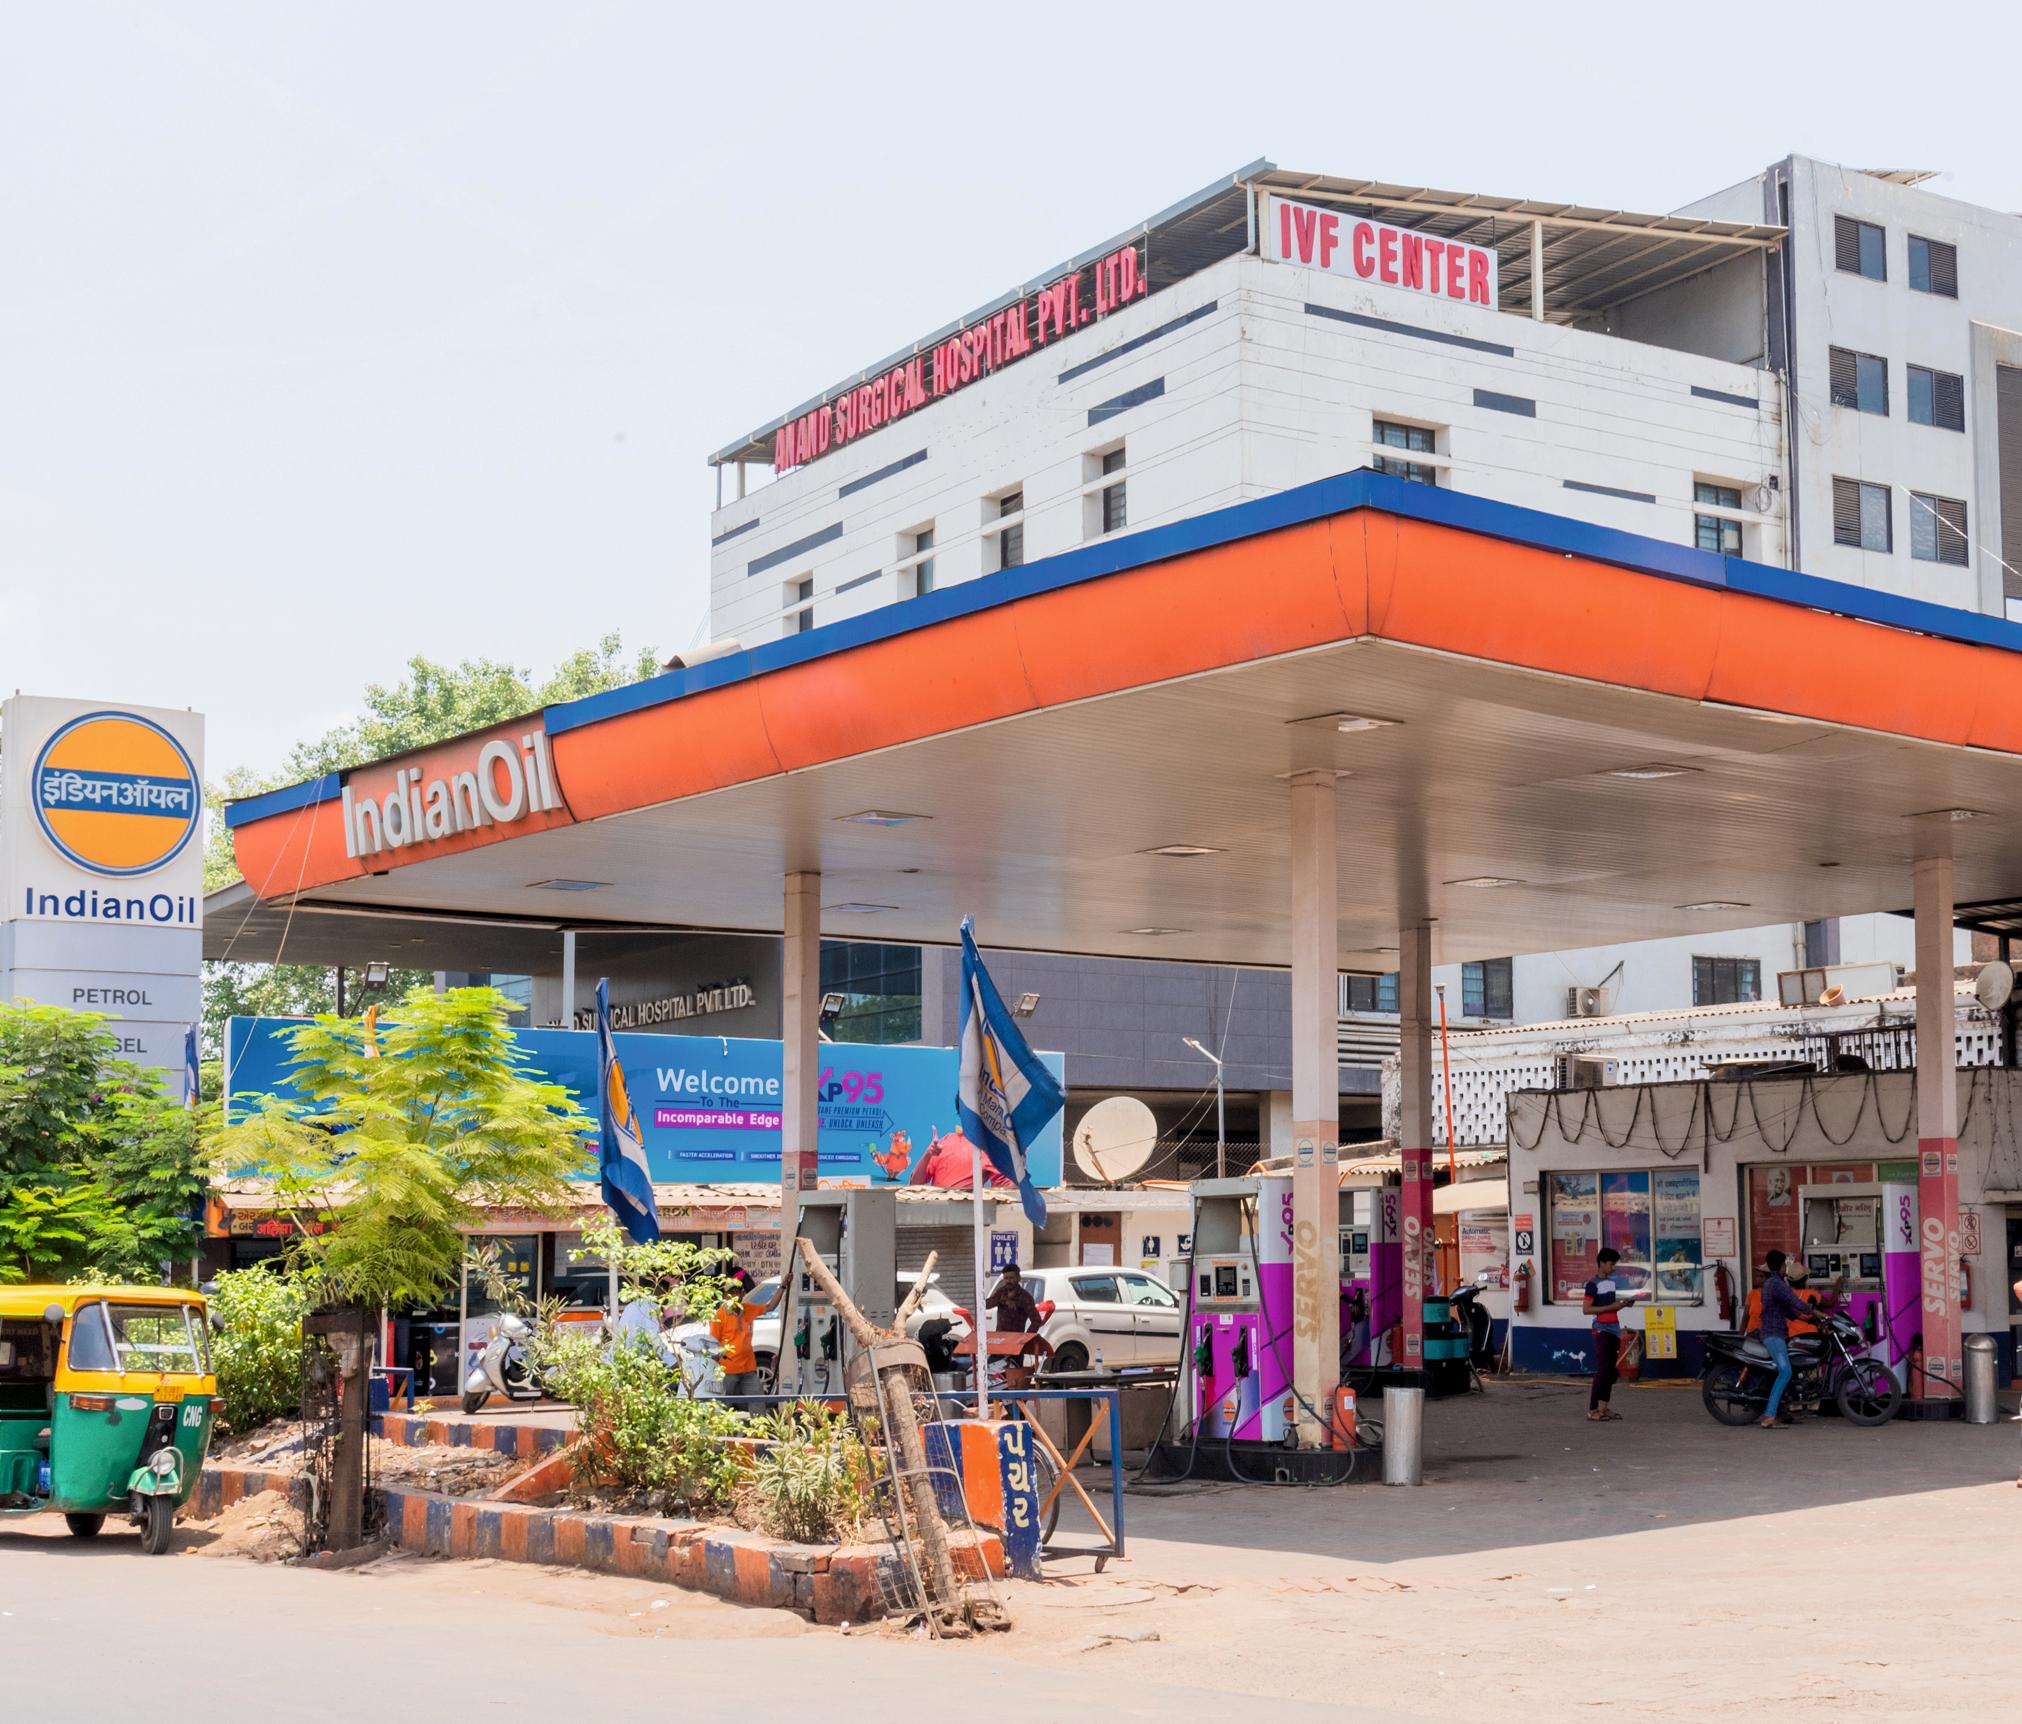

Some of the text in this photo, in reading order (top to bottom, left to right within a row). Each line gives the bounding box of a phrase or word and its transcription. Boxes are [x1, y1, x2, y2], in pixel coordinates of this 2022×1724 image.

[1281, 203, 1491, 306] IVF CENTER
[774, 246, 1147, 474] ANAND SURGICAL HOSPITAL PVT. LTD.
[42, 771, 191, 811] इंडियनऑयल
[341, 730, 563, 859] IndianOil
[25, 887, 195, 923] IndianOil
[72, 988, 152, 1006] PETROL
[582, 1006, 636, 1032] SUICAL
[637, 996, 694, 1025] HOSPITAL
[656, 1067, 780, 1096] Welcome
[657, 1110, 780, 1128] Incomparable Edge
[700, 1095, 740, 1109] To The
[833, 1106, 860, 1116] PREMIUM
[863, 1107, 882, 1116] PETROL
[657, 1206, 691, 1217] EROX
[1384, 1194, 1397, 1237] XP95
[1899, 1194, 1913, 1246] XP95
[991, 1234, 1017, 1242] TOILET
[1404, 1215, 1421, 1300] SERVO
[1423, 1226, 1435, 1287] SERVO
[1295, 1219, 1319, 1344] SERVO
[1922, 1216, 1946, 1317] SERVO
[1947, 1230, 1962, 1302] SERVO
[182, 1405, 202, 1428] CNG
